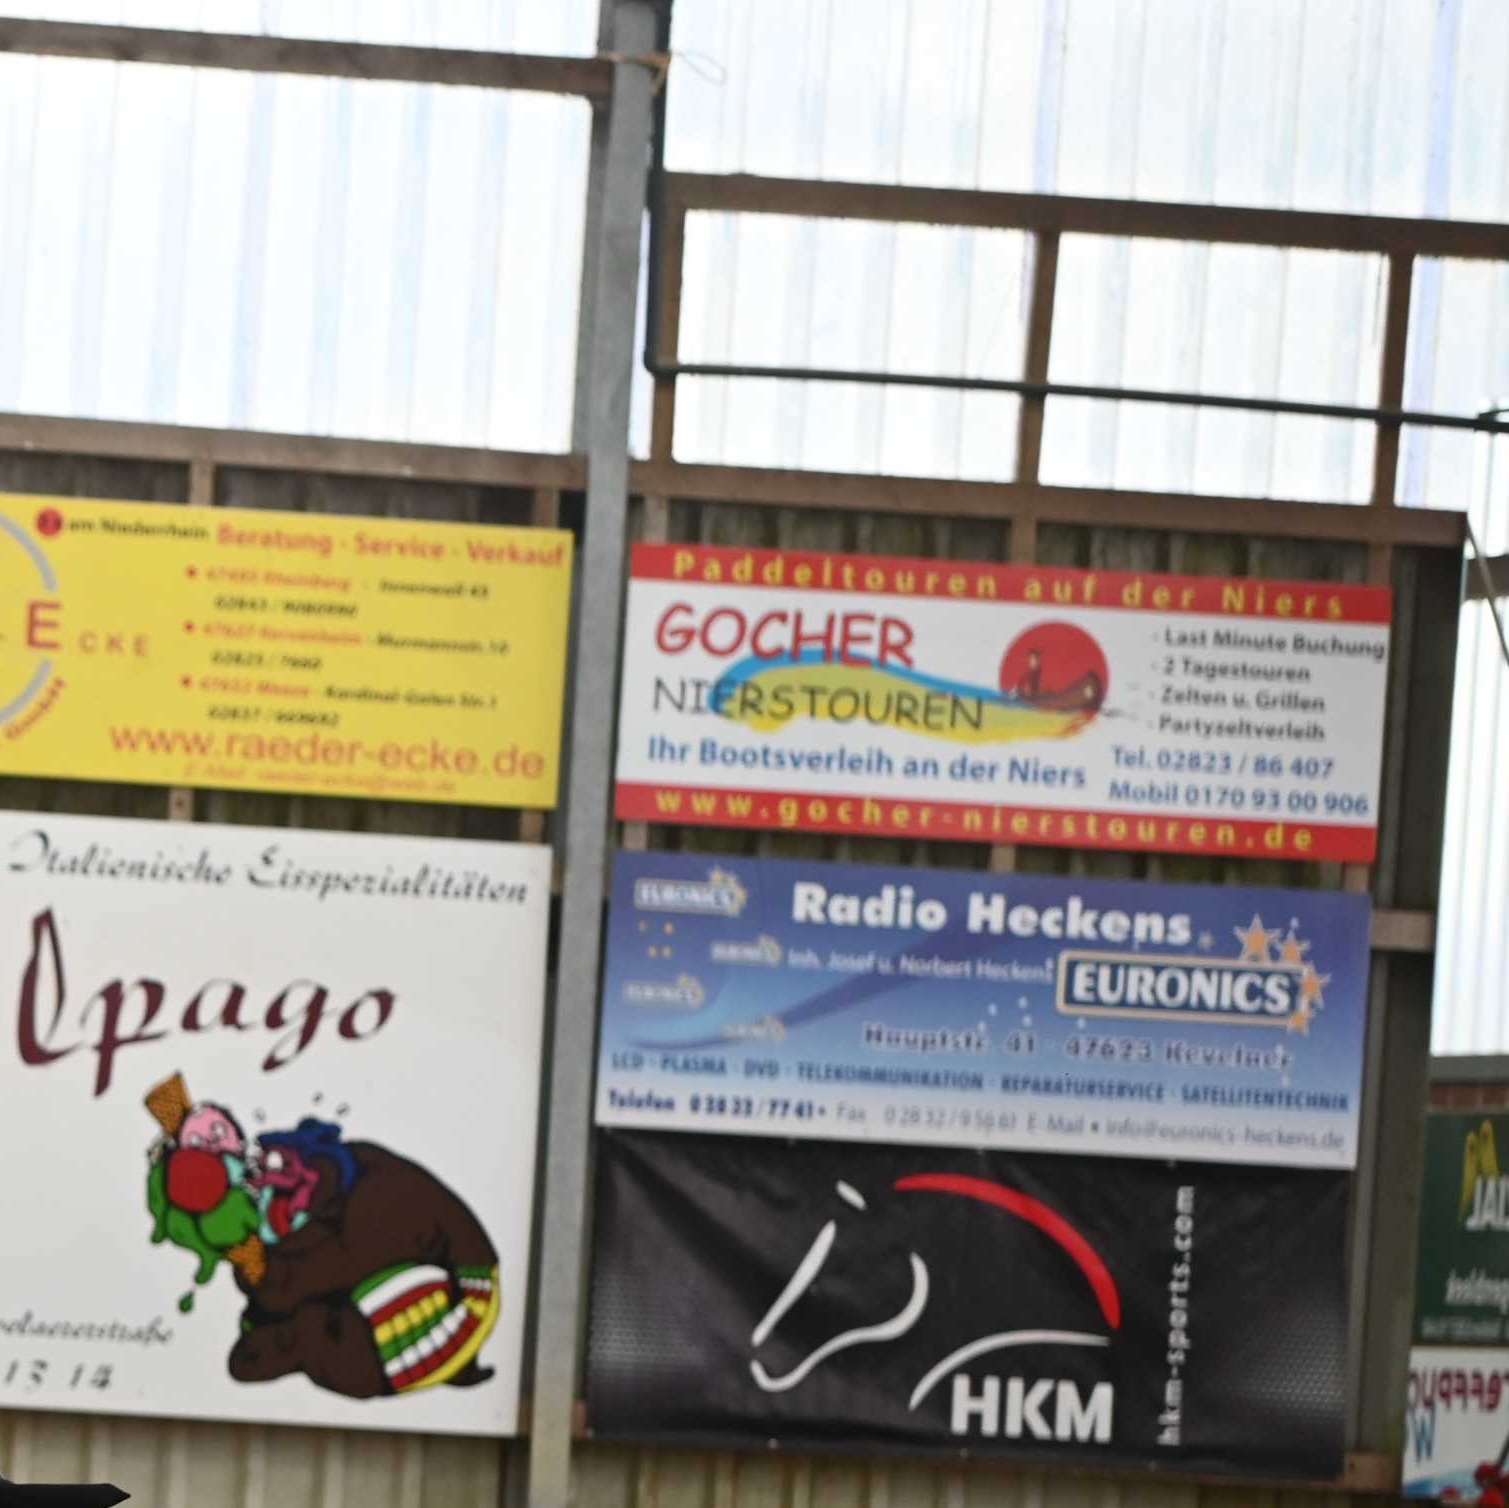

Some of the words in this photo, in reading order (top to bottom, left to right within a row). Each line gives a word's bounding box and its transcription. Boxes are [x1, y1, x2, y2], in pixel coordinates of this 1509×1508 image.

[217, 523, 333, 558] Beratung
[355, 533, 446, 562] Service
[465, 538, 564, 569] Verkauf
[673, 550, 998, 599] Paddeltouren
[1024, 573, 1098, 604] auf
[1121, 576, 1196, 611] der
[1221, 584, 1344, 619] Niers
[654, 601, 916, 670] GOCHER
[1164, 625, 1207, 647] Last
[1213, 629, 1287, 653] Minute
[1292, 633, 1386, 664] Buchung
[652, 676, 983, 733] NIERSTOUREN
[1161, 686, 1228, 708] Zelten
[1255, 690, 1326, 714] Grillen
[110, 726, 546, 781] www.raeder-ecke.de
[648, 735, 691, 764] Ihr
[698, 738, 894, 777] Bootsverleih
[902, 755, 941, 780] an
[948, 752, 1001, 784] der
[1007, 756, 1087, 790] Niers
[1112, 744, 1151, 770] Tel.
[656, 790, 1313, 850] www.gocher-nierstouren.de
[1109, 780, 1180, 805] Mobil
[1185, 784, 1246, 811] 0170
[1287, 789, 1319, 814] 00
[9, 829, 232, 888] Italienische
[792, 881, 949, 932] Radio
[966, 892, 1192, 946] Heckens
[1072, 962, 1292, 1014] EURONICS
[1157, 1185, 1195, 1446] hkm-sports.com
[950, 1372, 1115, 1444] HKM
